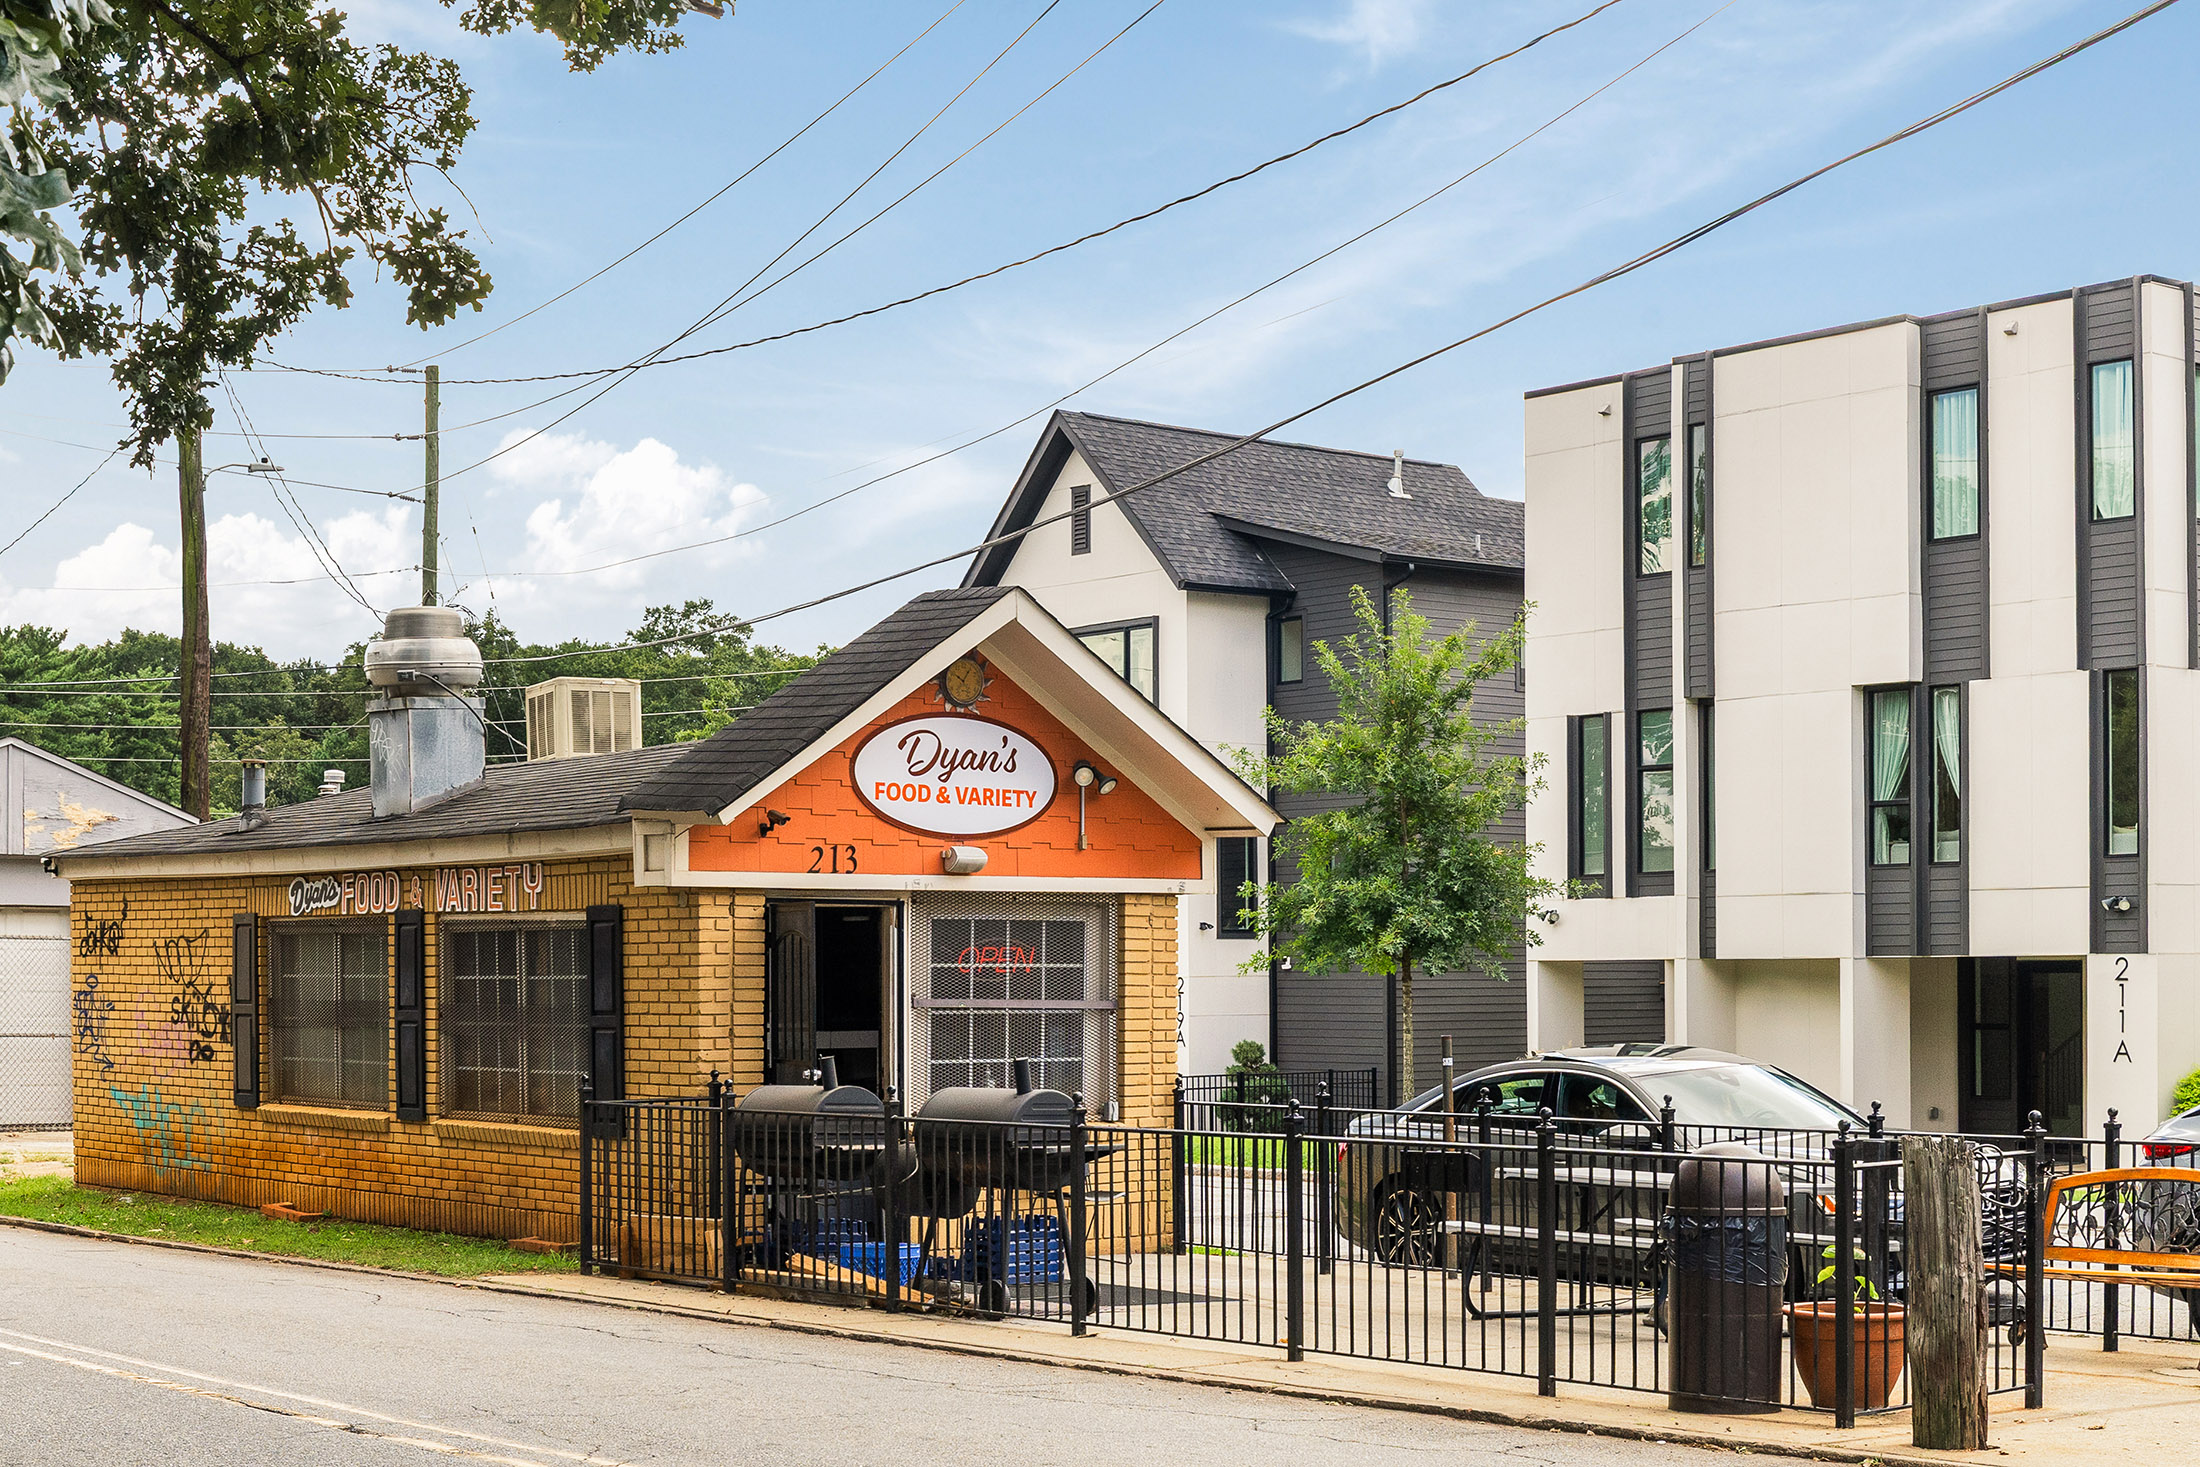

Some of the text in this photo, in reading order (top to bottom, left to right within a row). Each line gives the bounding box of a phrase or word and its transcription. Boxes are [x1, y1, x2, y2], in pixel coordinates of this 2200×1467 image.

[898, 730, 1018, 783] Dyan's
[875, 782, 1037, 808] FOOD & VARIETY
[807, 844, 858, 874] 213
[289, 863, 543, 916] Dyan's FOOD & VARIETY
[958, 947, 1035, 973] OPEN
[1177, 976, 1186, 1047] 219A
[2113, 957, 2132, 1063] 211A
